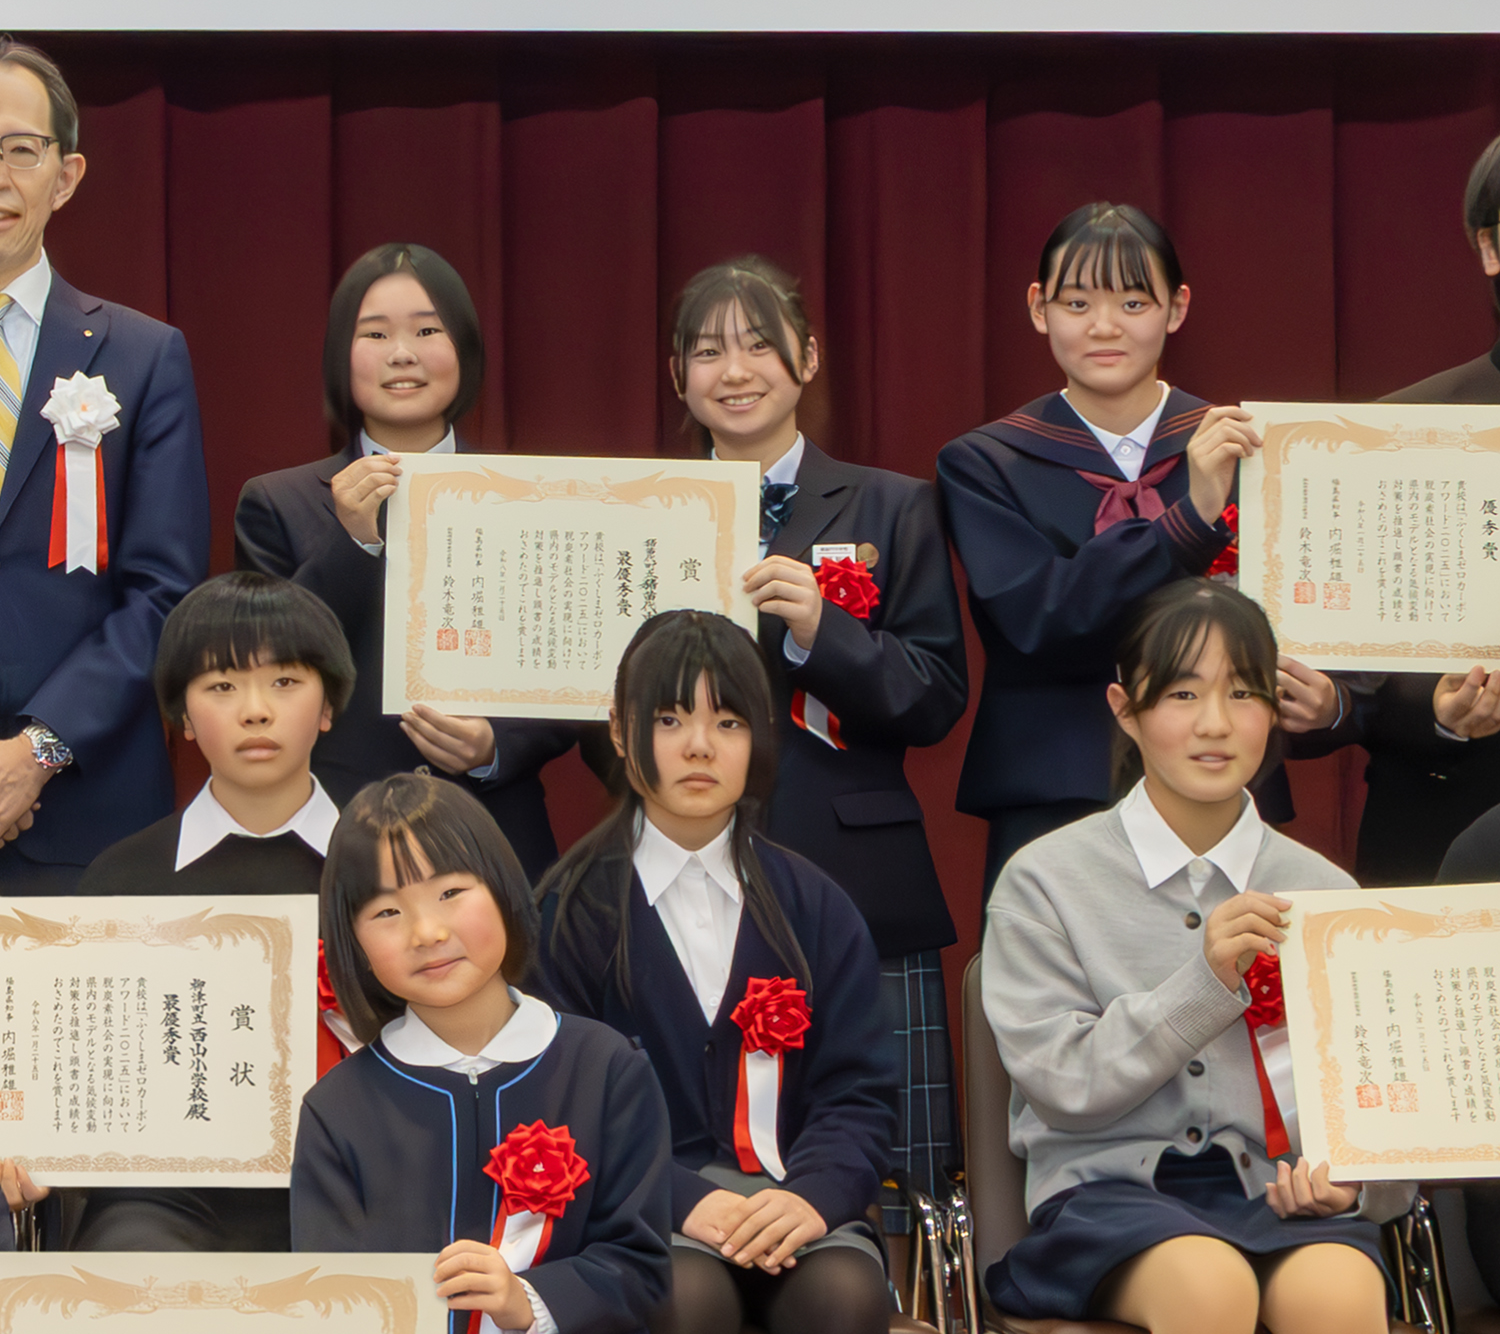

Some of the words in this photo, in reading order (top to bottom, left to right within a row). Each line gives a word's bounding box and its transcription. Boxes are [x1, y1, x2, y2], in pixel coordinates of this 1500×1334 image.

[1480, 499, 1499, 562] 優秀賞
[612, 550, 633, 618] 最優秀賞
[678, 557, 702, 582] 賞
[160, 993, 183, 1066] 最優秀賞
[183, 977, 211, 1122] 柳津町立西山小学校殿
[229, 1003, 256, 1087] 賞状
